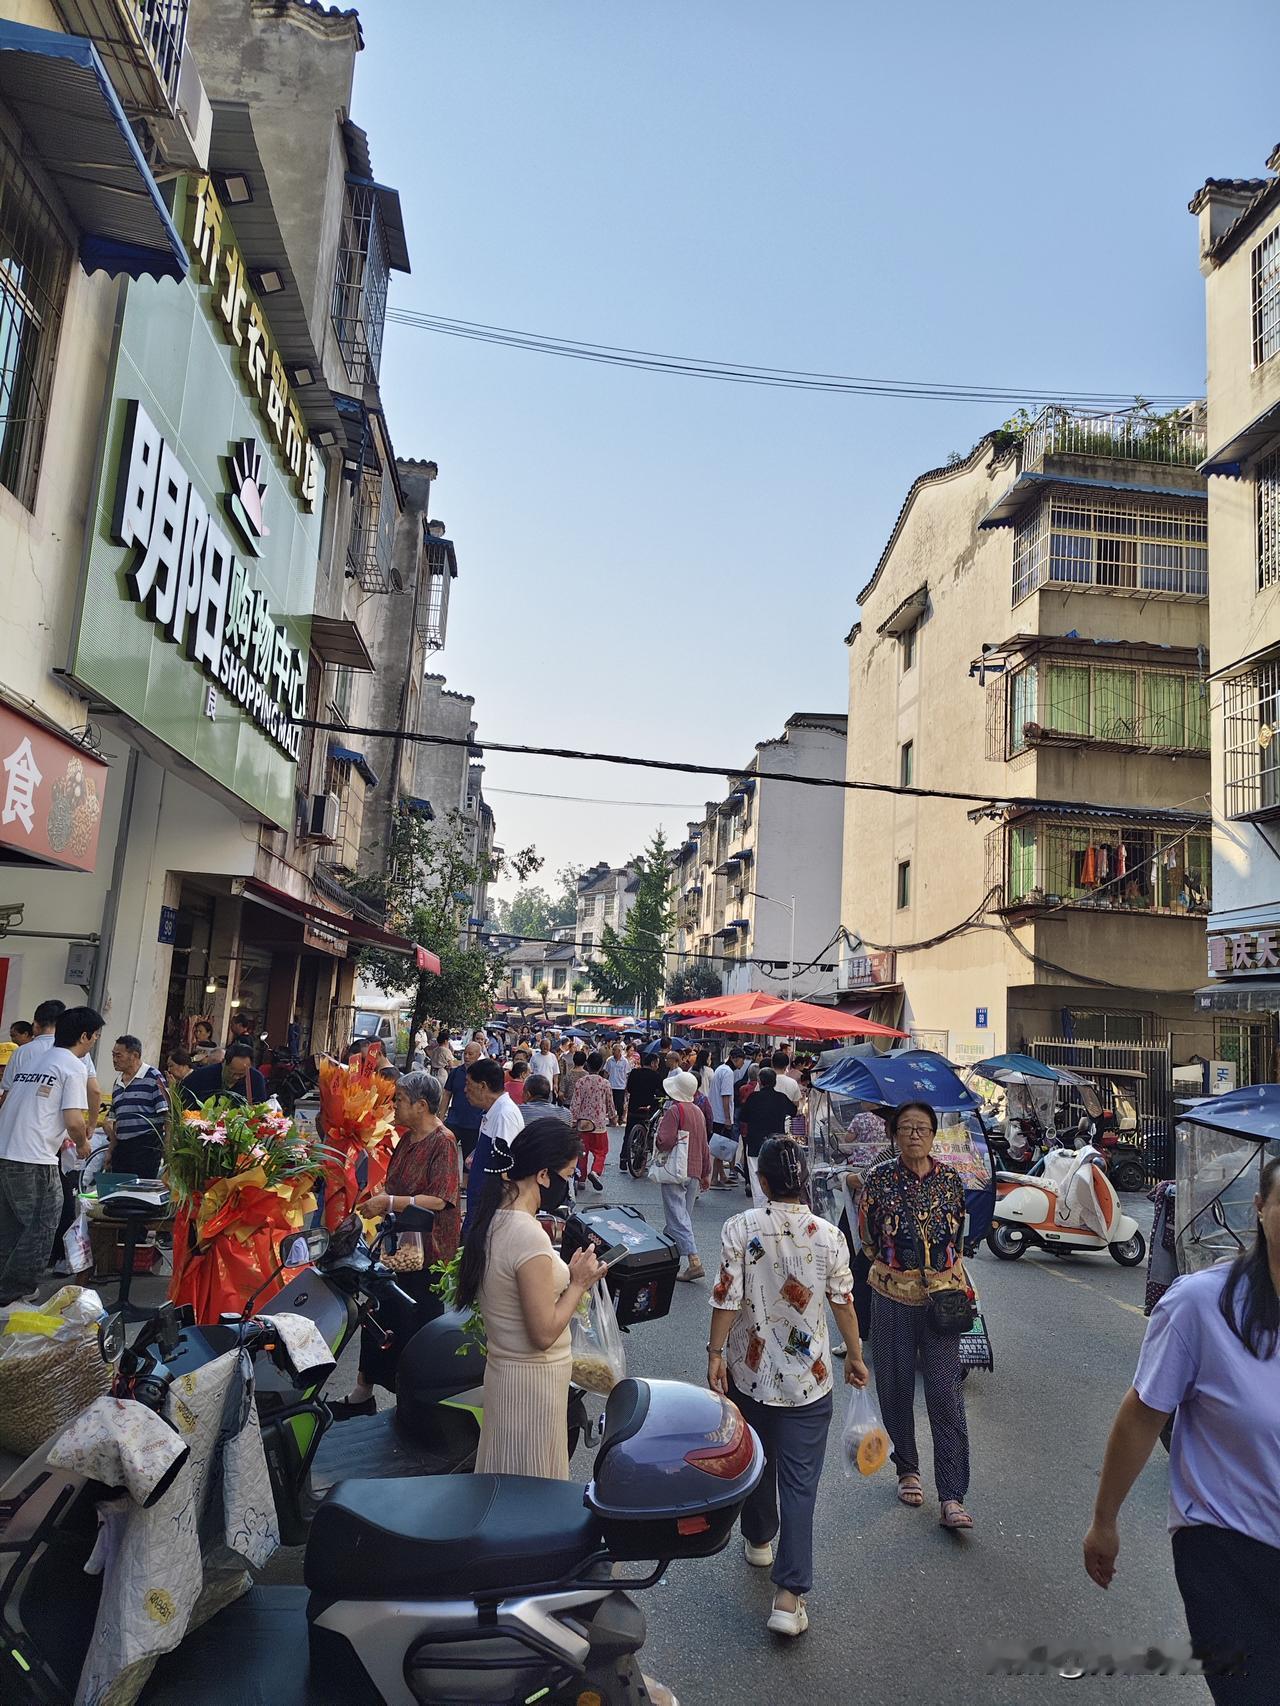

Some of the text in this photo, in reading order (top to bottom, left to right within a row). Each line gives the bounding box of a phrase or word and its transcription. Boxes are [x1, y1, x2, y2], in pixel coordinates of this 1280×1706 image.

[219, 643, 300, 764] SHOPPING MALL
[1, 735, 43, 835] 食
